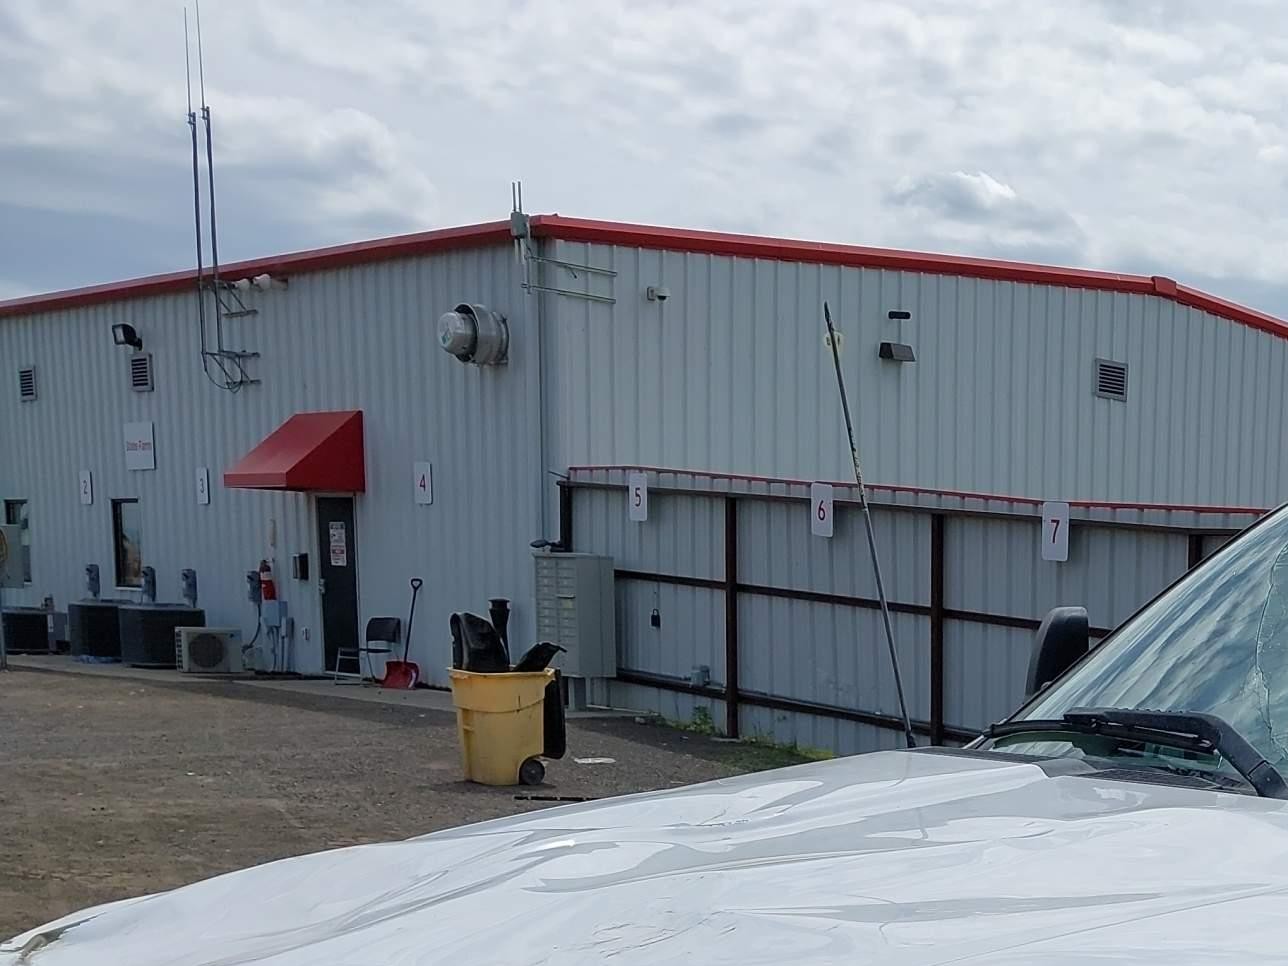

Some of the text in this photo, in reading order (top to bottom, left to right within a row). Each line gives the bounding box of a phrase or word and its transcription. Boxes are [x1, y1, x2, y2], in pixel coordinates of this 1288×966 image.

[83, 479, 88, 494] 2
[199, 478, 205, 493] 3
[419, 473, 426, 492] 4
[634, 487, 642, 507] 5
[817, 499, 826, 521] 6
[1050, 519, 1060, 544] 7
